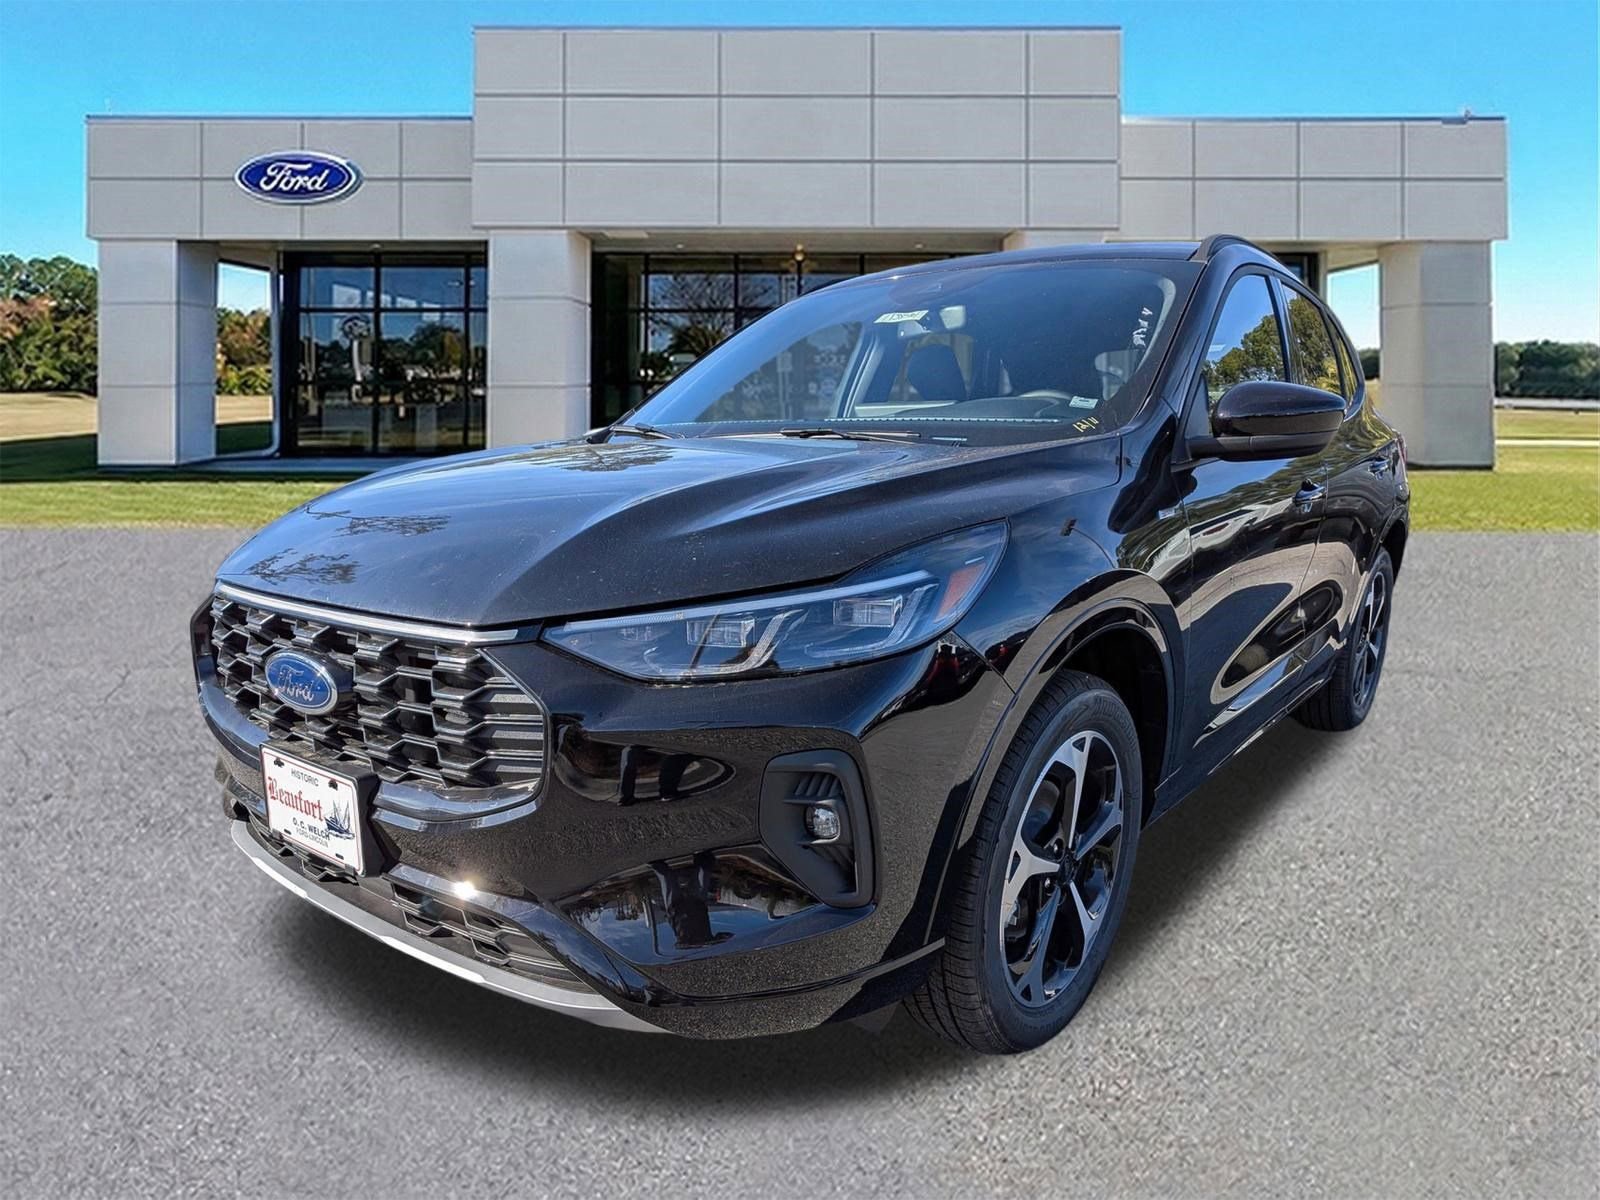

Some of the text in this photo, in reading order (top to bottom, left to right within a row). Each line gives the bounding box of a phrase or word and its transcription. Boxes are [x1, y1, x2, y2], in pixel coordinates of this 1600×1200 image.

[259, 162, 329, 191] Ford
[278, 664, 314, 701] Ford
[291, 768, 319, 787] HISTORIC
[267, 776, 325, 822] Beaufort
[307, 823, 330, 841] WELCH
